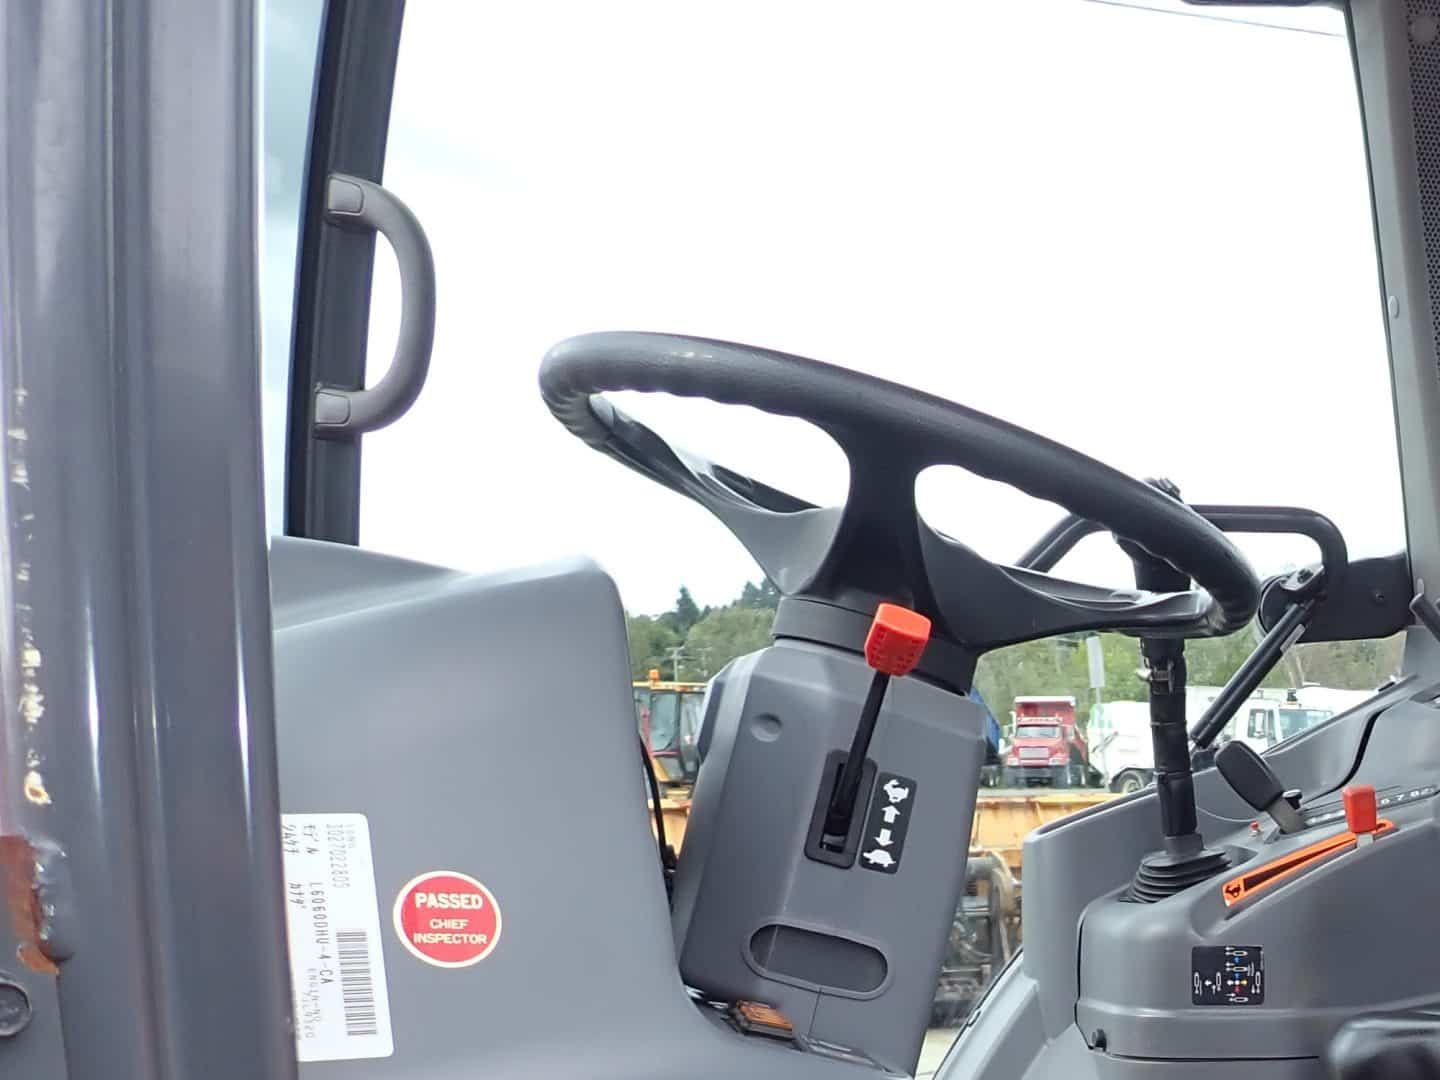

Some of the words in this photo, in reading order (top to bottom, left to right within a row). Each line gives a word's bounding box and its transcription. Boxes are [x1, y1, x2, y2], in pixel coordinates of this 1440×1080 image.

[415, 892, 484, 910] PASSED
[429, 918, 469, 929] CHIEF
[413, 933, 488, 944] INSPECTOR
